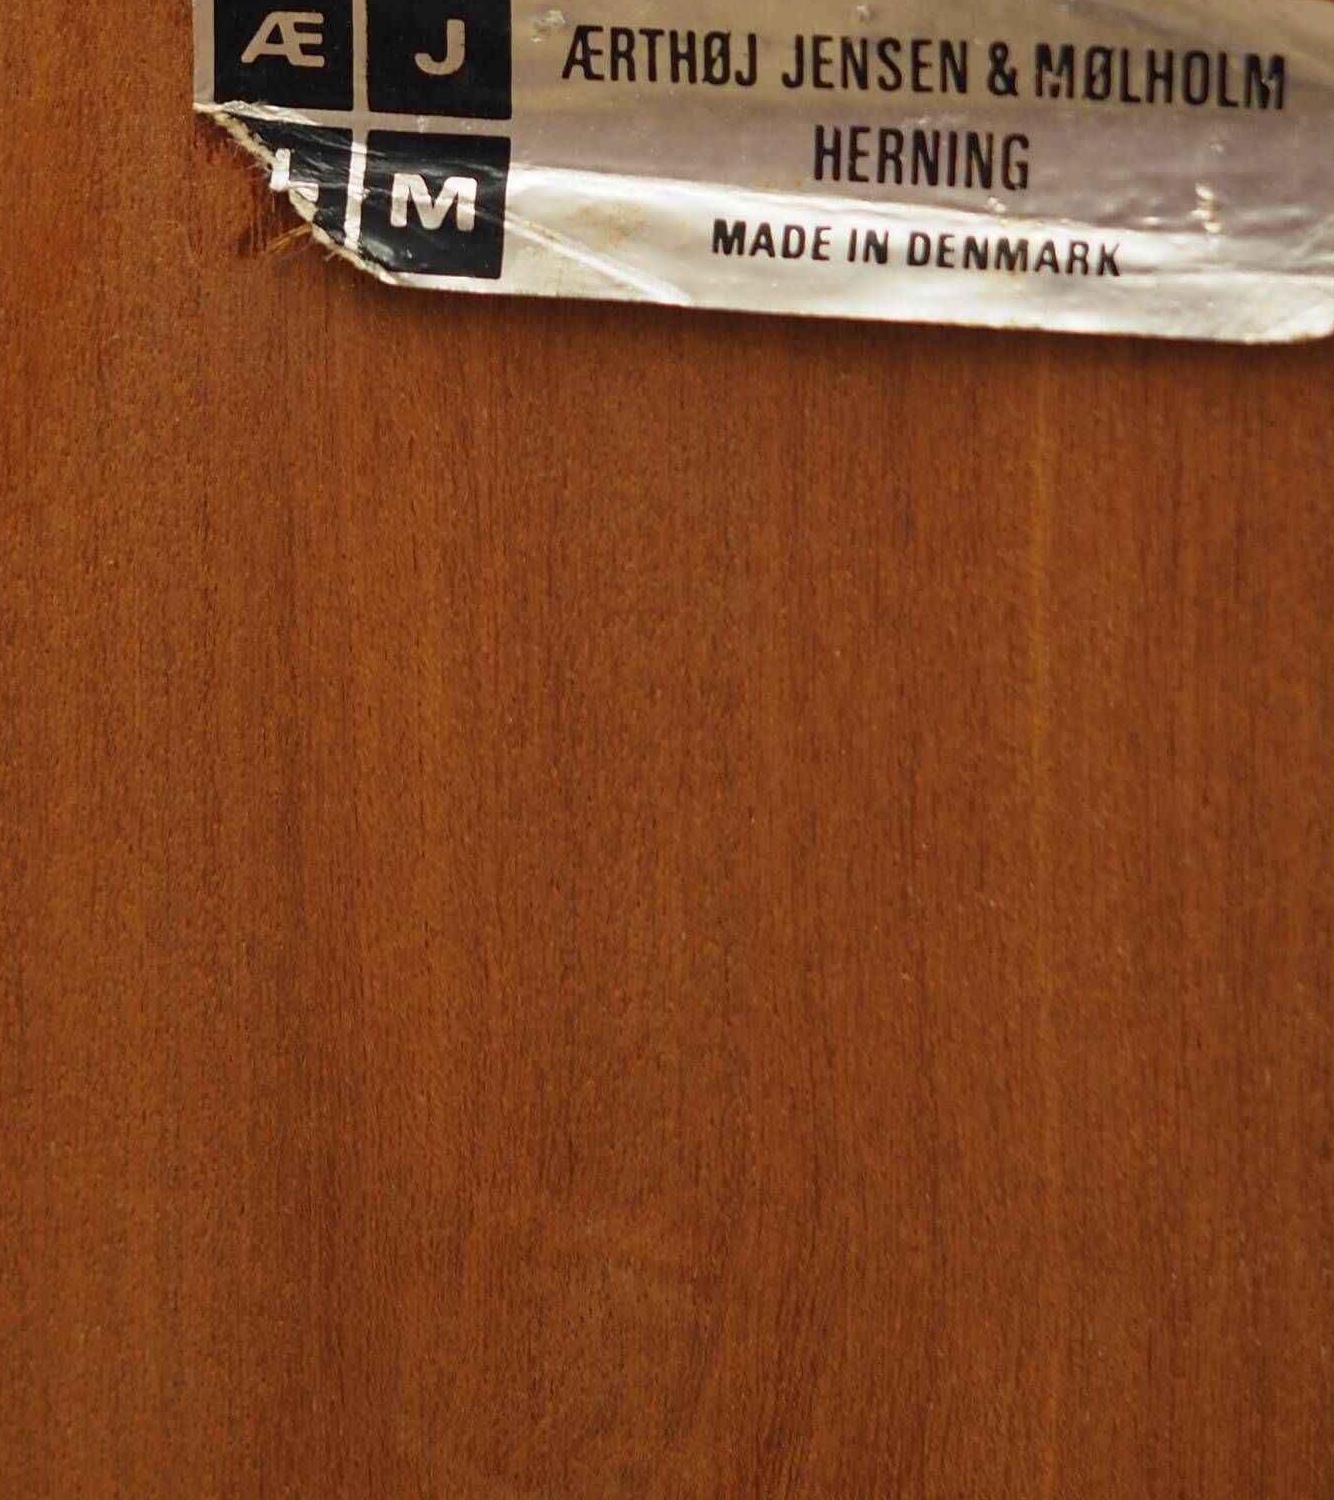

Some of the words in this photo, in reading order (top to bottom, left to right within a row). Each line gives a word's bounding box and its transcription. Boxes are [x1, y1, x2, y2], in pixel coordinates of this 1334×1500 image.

[240, 10, 326, 68] Æ
[414, 18, 466, 76] J
[561, 24, 758, 88] ÆRTHØJ
[781, 33, 969, 96] JENSEN
[986, 41, 1019, 98] &
[1034, 43, 1287, 112] MØLHOLM
[812, 124, 1031, 192] HERNING
[388, 171, 480, 232] M
[711, 218, 832, 263] MADE
[846, 229, 889, 266] IN
[906, 232, 1122, 277] DENMARK
